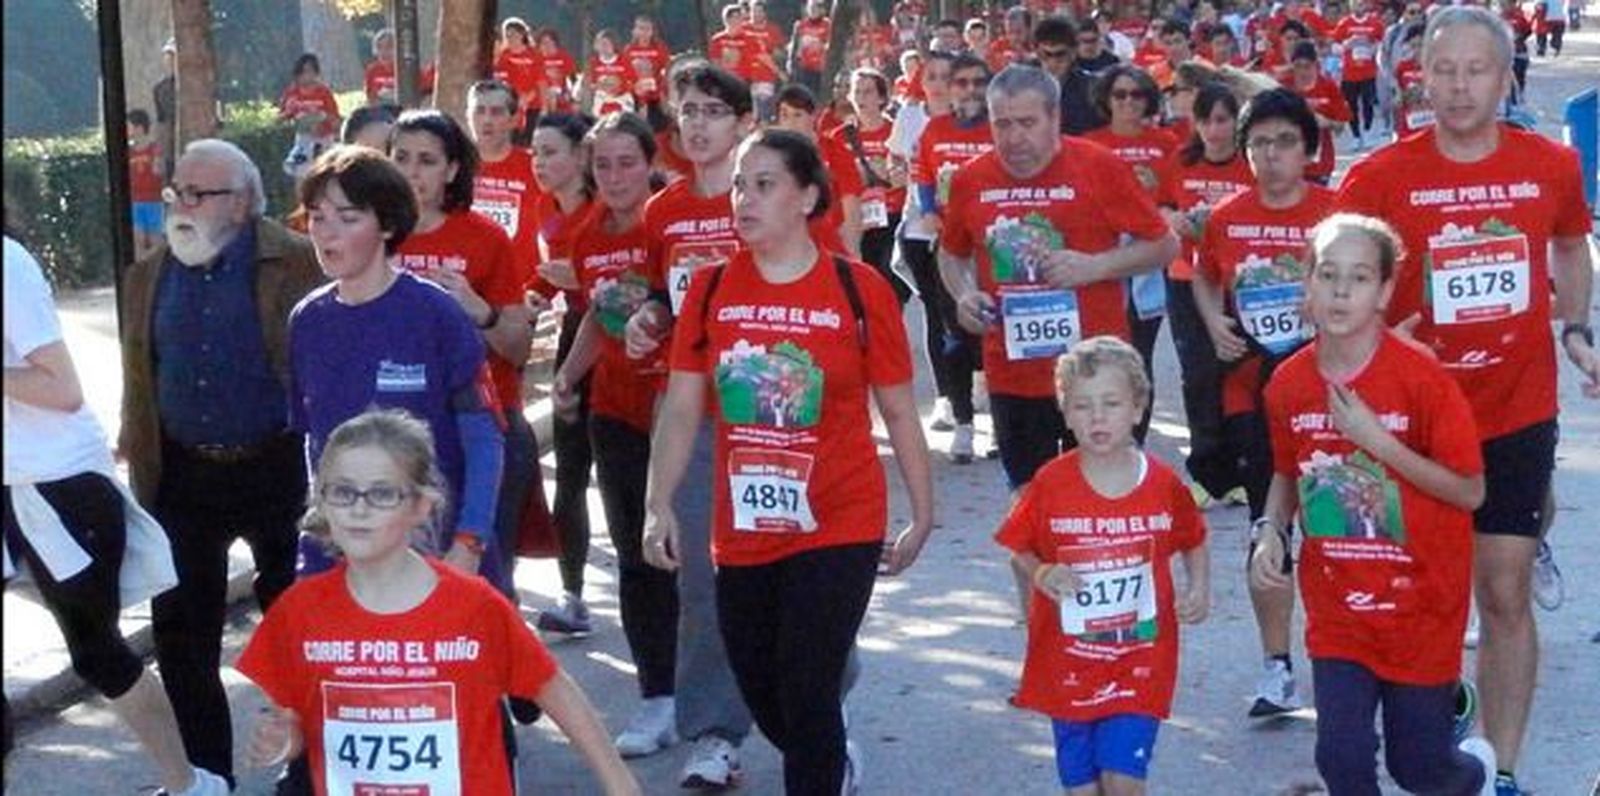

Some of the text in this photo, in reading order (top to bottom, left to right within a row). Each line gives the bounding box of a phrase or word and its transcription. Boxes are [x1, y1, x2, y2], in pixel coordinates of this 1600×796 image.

[1458, 185, 1487, 202] POR
[1489, 185, 1506, 200] EL
[1447, 269, 1516, 299] 6178
[758, 305, 787, 322] POR
[789, 307, 807, 325] EL
[1013, 318, 1072, 342] 1966
[742, 484, 800, 513] 4847
[1096, 517, 1127, 534] POR
[1129, 515, 1147, 532] EL
[1075, 573, 1143, 607] 6177
[360, 640, 400, 662] POR
[404, 641, 429, 663] EL
[434, 636, 480, 662] NIÑO
[337, 733, 443, 772] 4754
